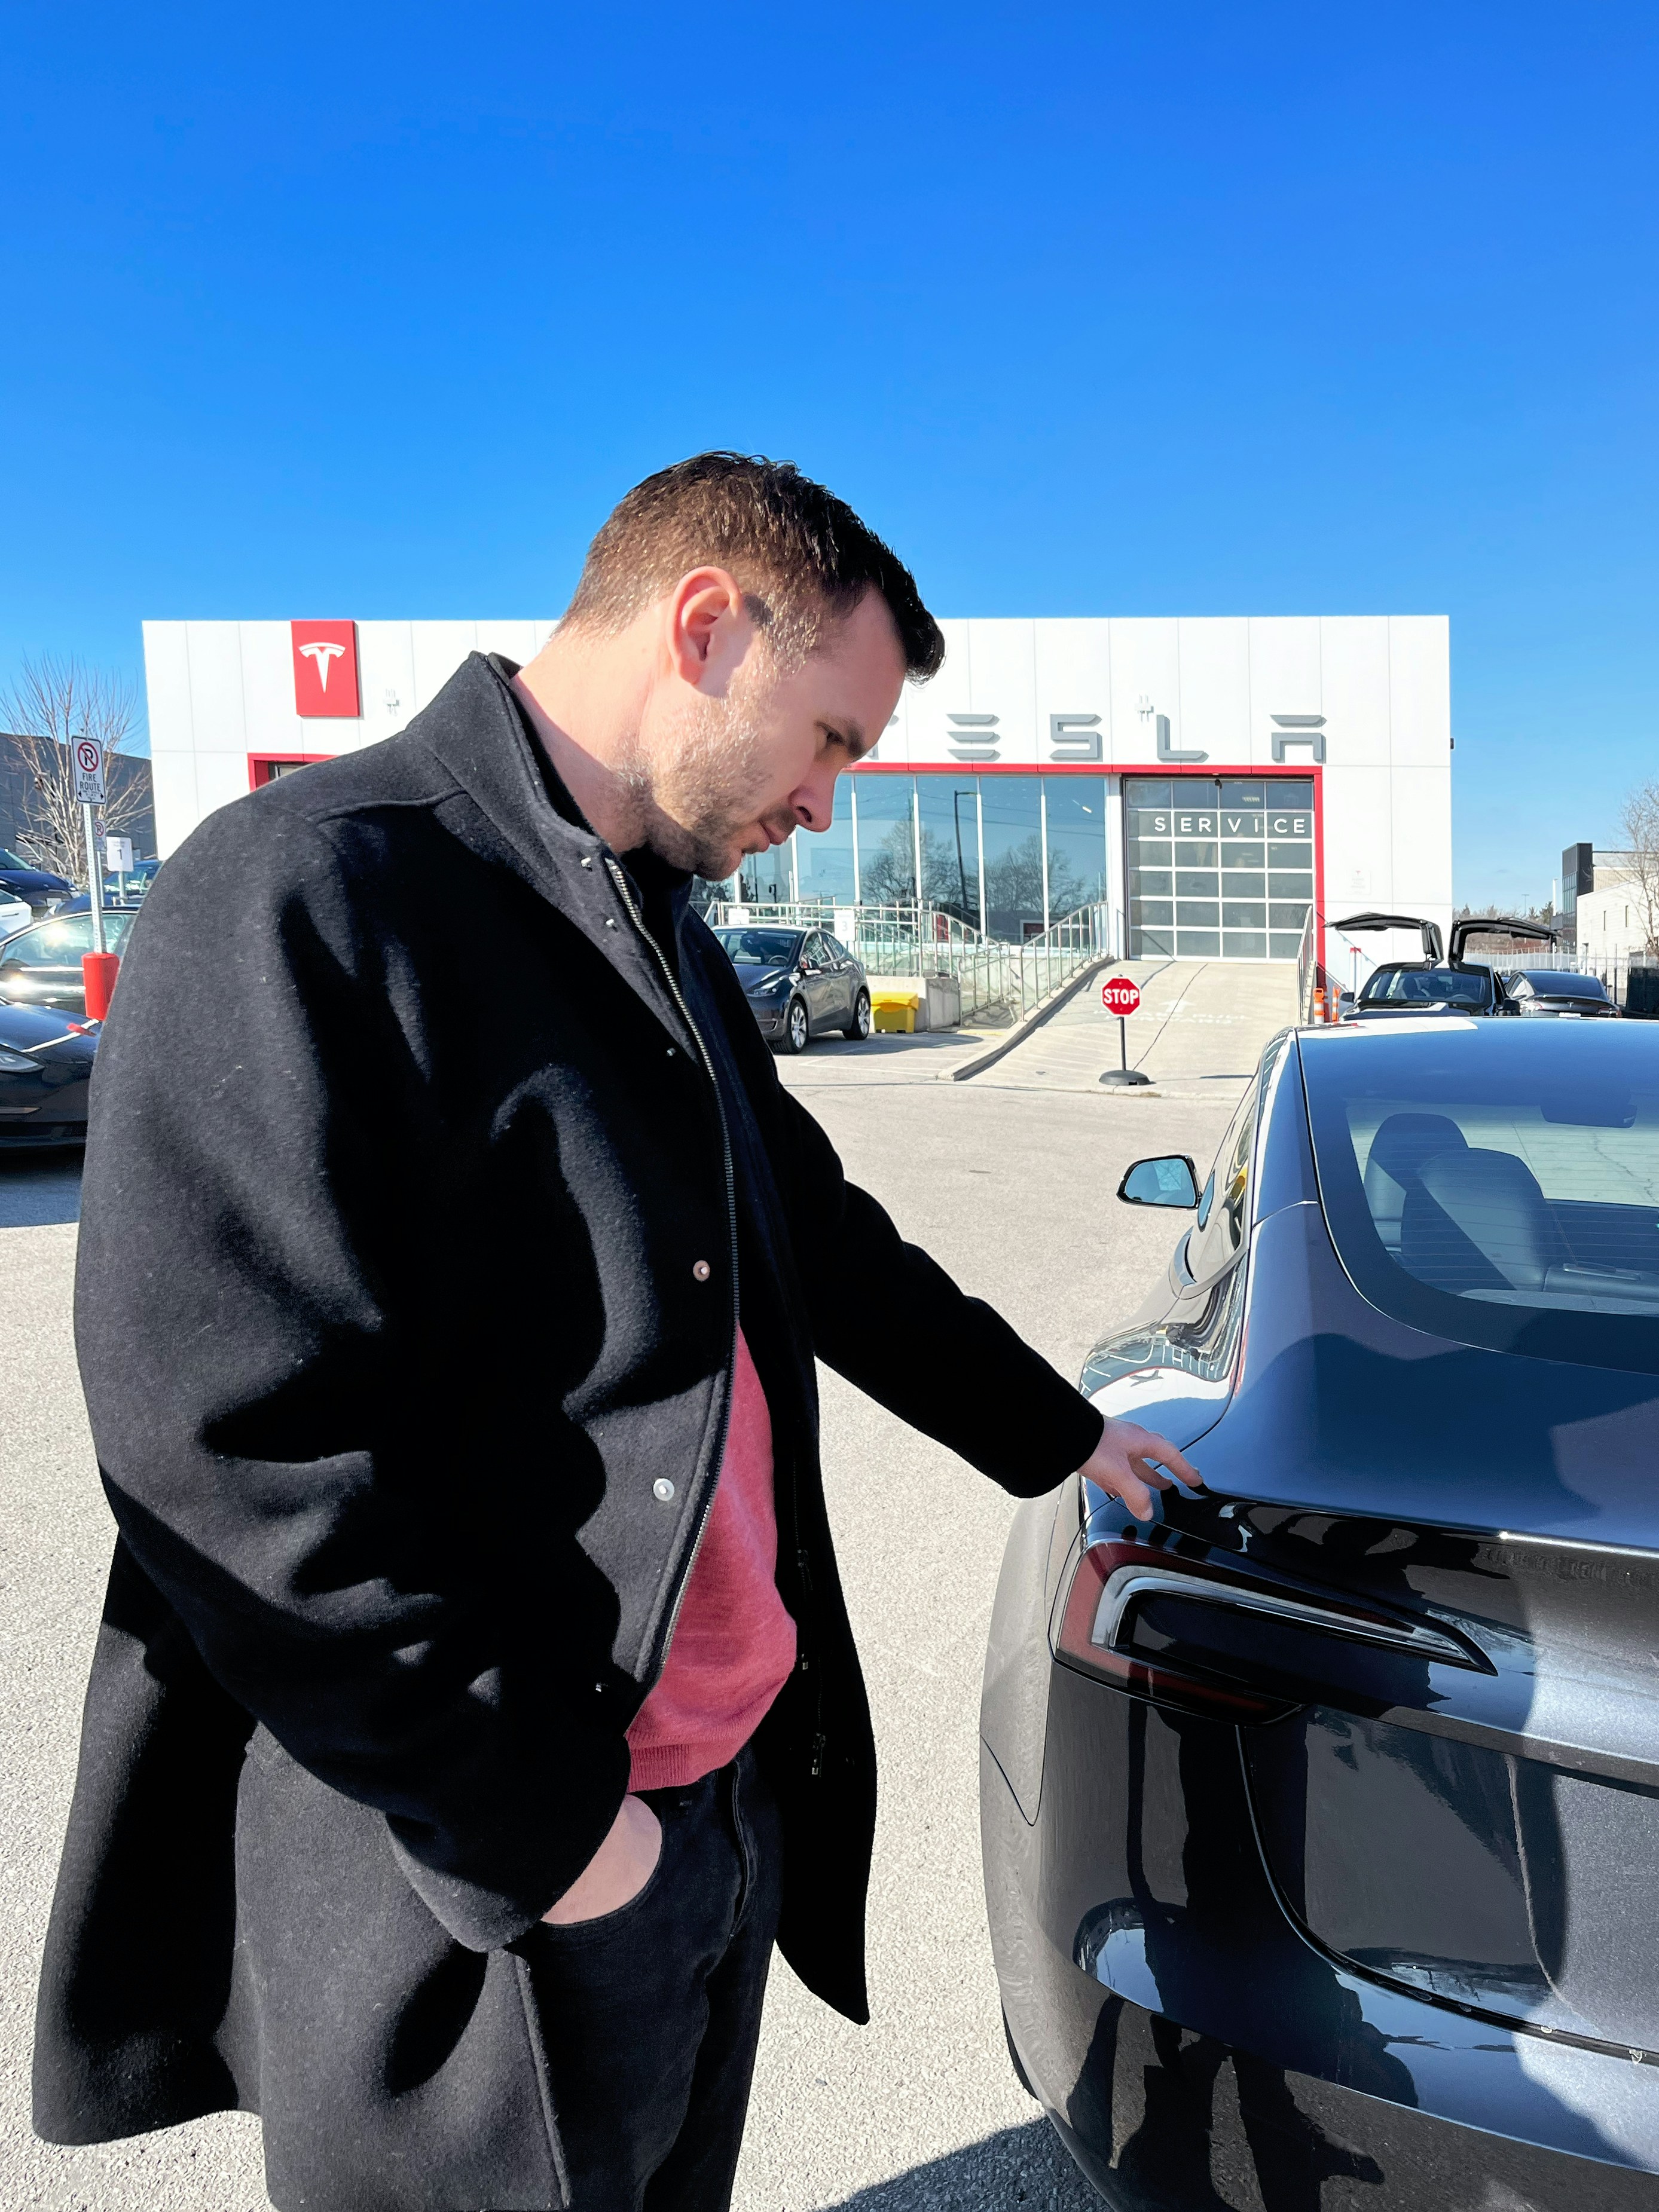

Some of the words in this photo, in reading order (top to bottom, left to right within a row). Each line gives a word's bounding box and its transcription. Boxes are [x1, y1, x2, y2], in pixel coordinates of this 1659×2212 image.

[867, 714, 1325, 764] ESLA
[82, 772, 97, 782] FIRE
[80, 781, 101, 791] ROUTE
[1154, 817, 1306, 833] SERVICE
[117, 849, 123, 860] 1
[842, 920, 848, 932] 3
[1104, 988, 1139, 1005] STOP
